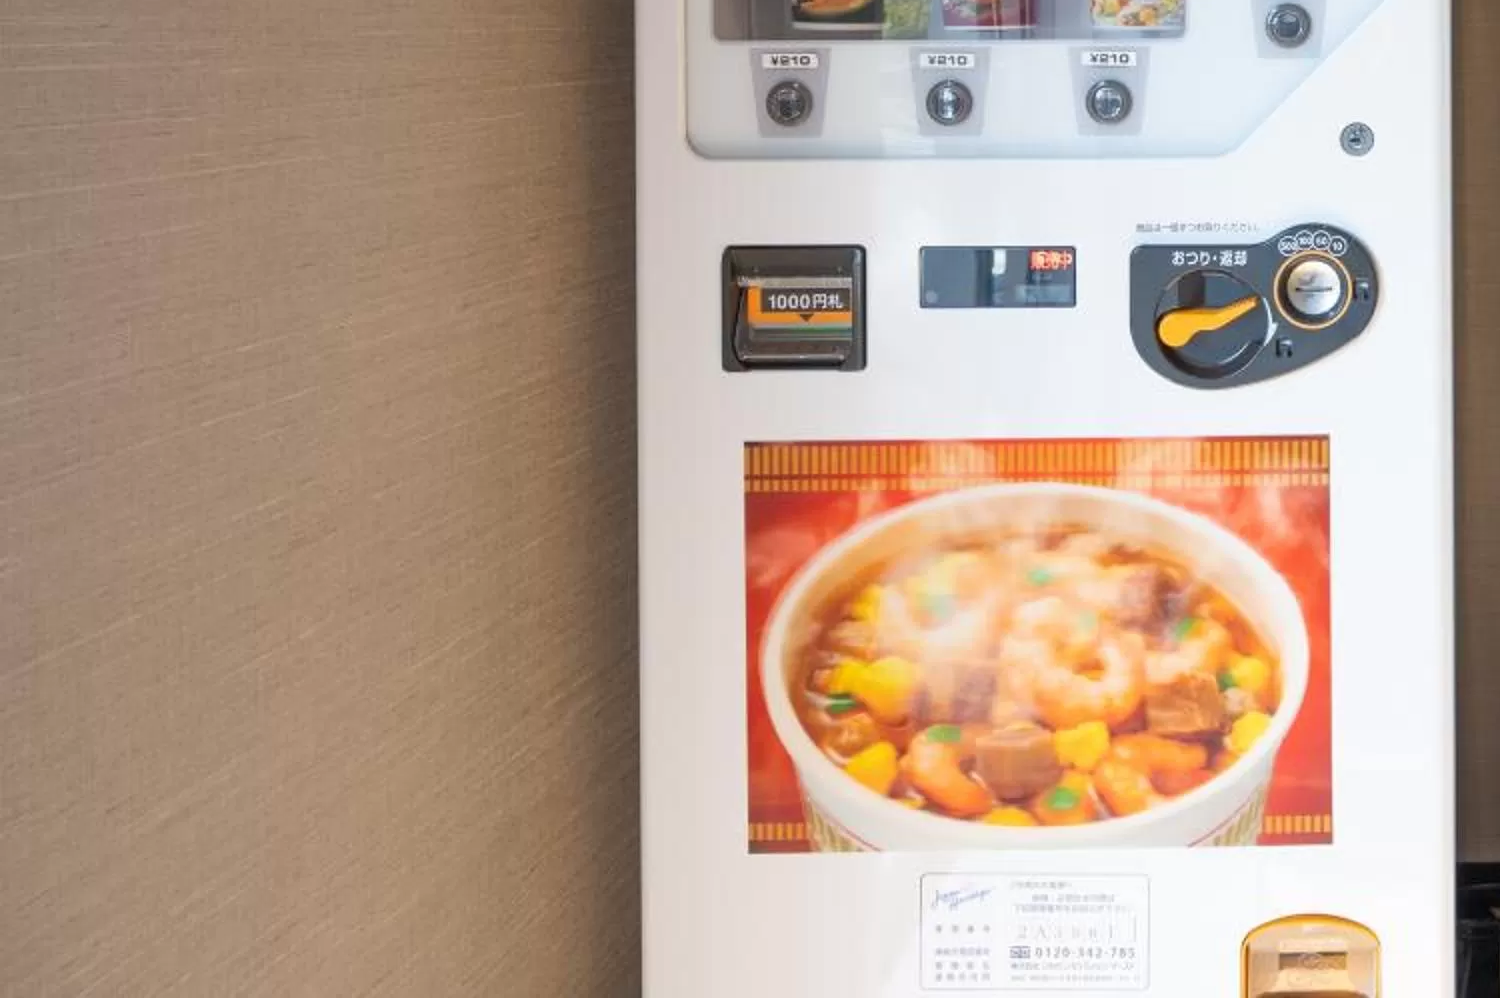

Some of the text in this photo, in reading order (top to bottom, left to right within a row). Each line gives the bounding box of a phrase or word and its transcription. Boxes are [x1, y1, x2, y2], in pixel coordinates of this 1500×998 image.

[770, 55, 811, 66] ¥210
[928, 55, 967, 65] ¥210
[1089, 53, 1129, 63] ¥210
[768, 293, 843, 310] 1000円札
[1035, 946, 1136, 958] 0120-342-785
